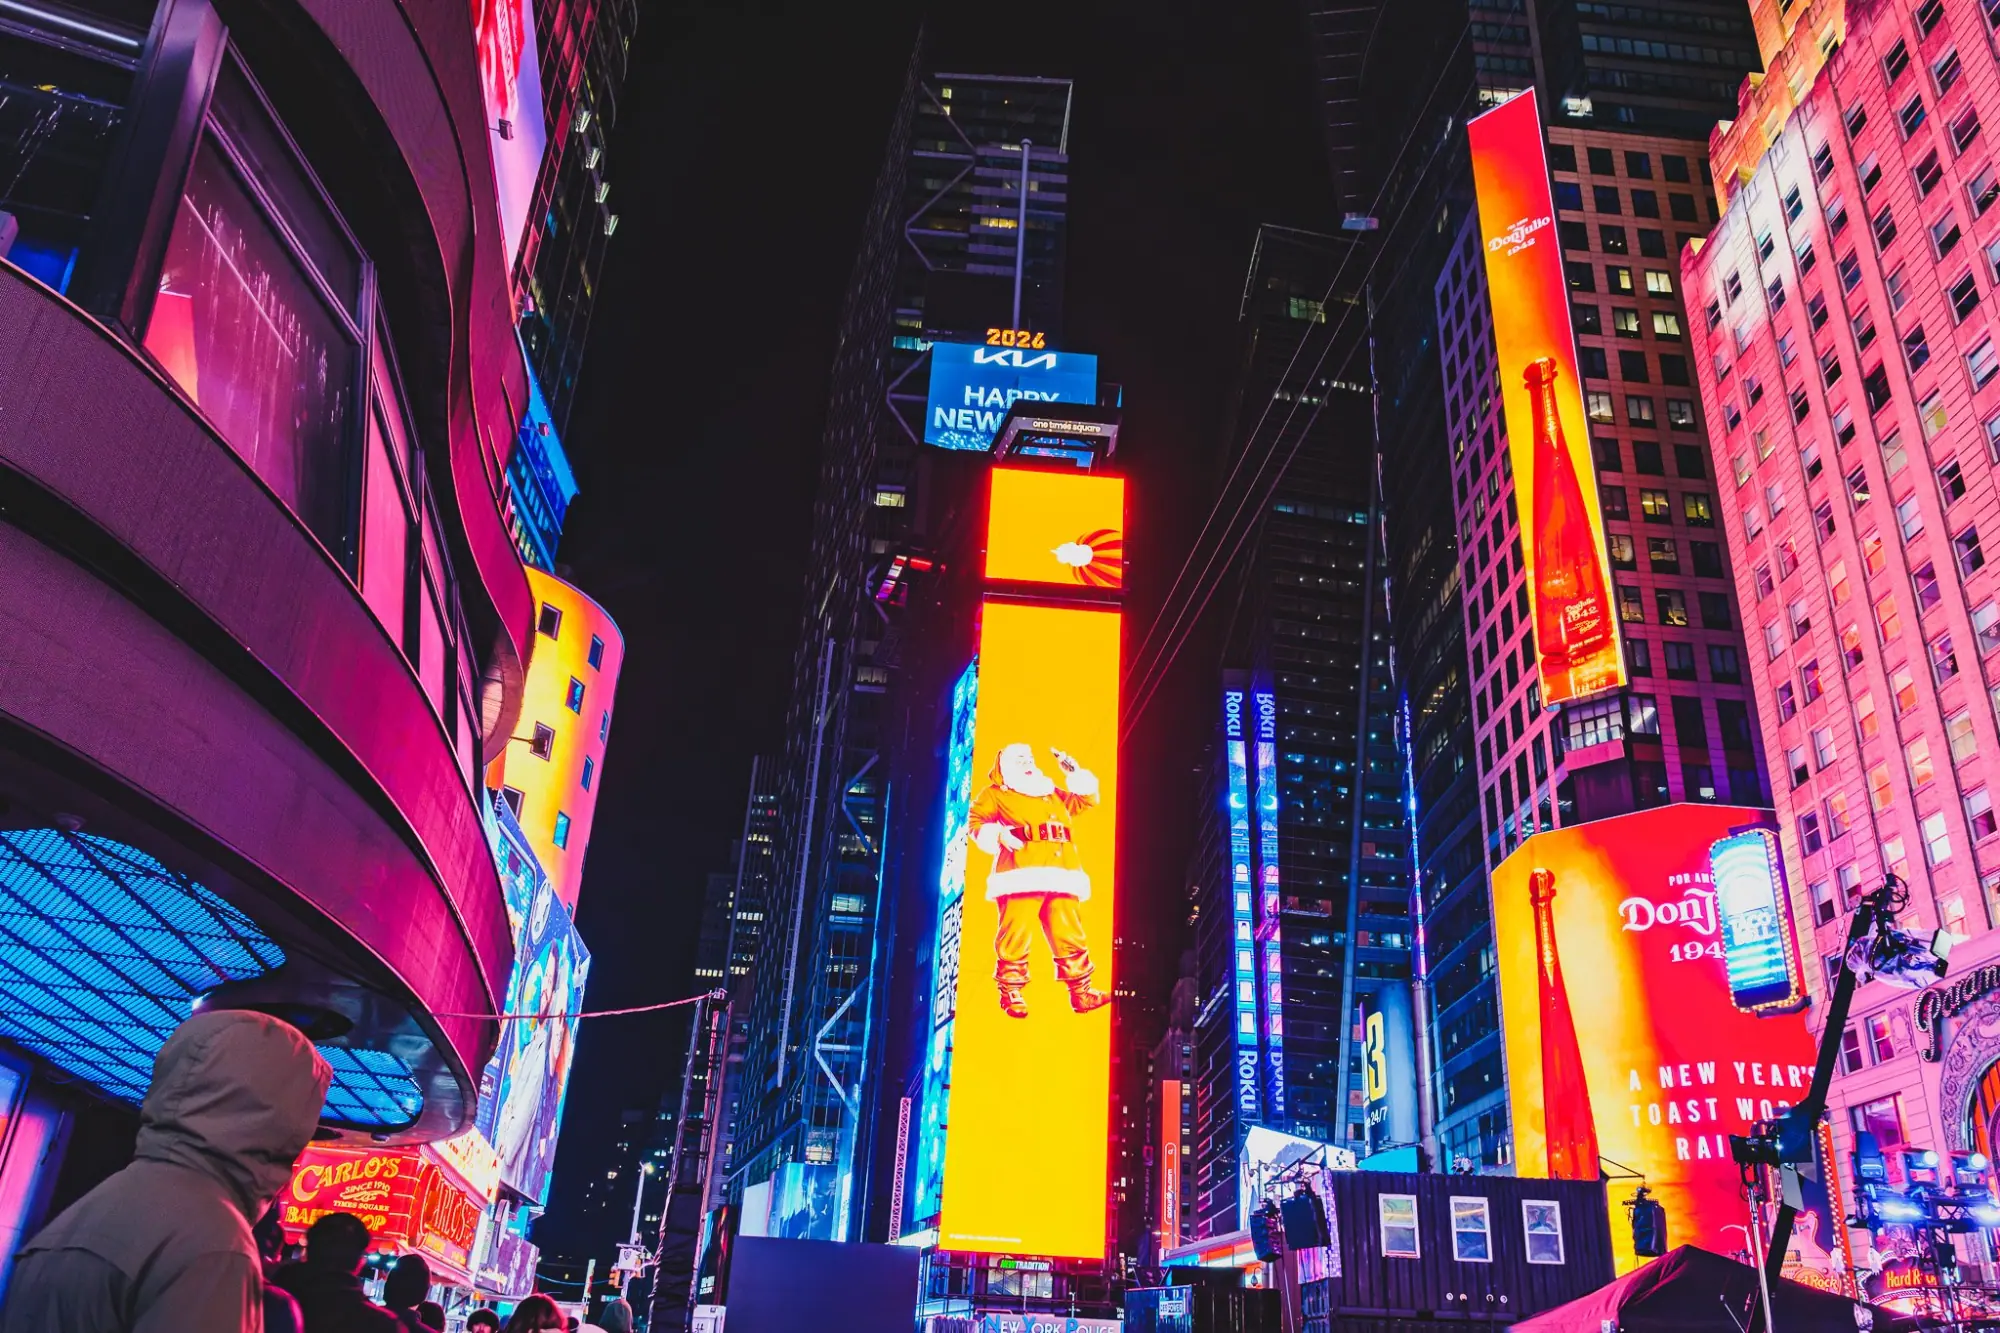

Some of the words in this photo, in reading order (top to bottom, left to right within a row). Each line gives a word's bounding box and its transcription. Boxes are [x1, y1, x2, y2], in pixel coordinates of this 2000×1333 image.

[986, 328, 1046, 349] 2026
[973, 347, 1057, 370] KIA
[933, 406, 1001, 434] NEW
[1032, 421, 1049, 429] one
[1049, 421, 1072, 430] times
[1072, 424, 1101, 433] square
[1668, 873, 1692, 887] POR
[1669, 941, 1725, 963] 194
[1629, 1069, 1643, 1092] A
[1659, 1061, 1716, 1089] NEW
[1629, 1097, 1718, 1127] TOAST
[292, 1157, 402, 1202] CARLO'S
[345, 1180, 373, 1194] SINCE
[373, 1180, 392, 1192] 1910
[333, 1200, 358, 1209] TIMES
[358, 1203, 390, 1212] SQUARE
[1885, 1268, 1912, 1288] Hard
[984, 1314, 1021, 1333] NEW
[1022, 1315, 1063, 1333] YORK
[1066, 1317, 1116, 1333] POLICE
